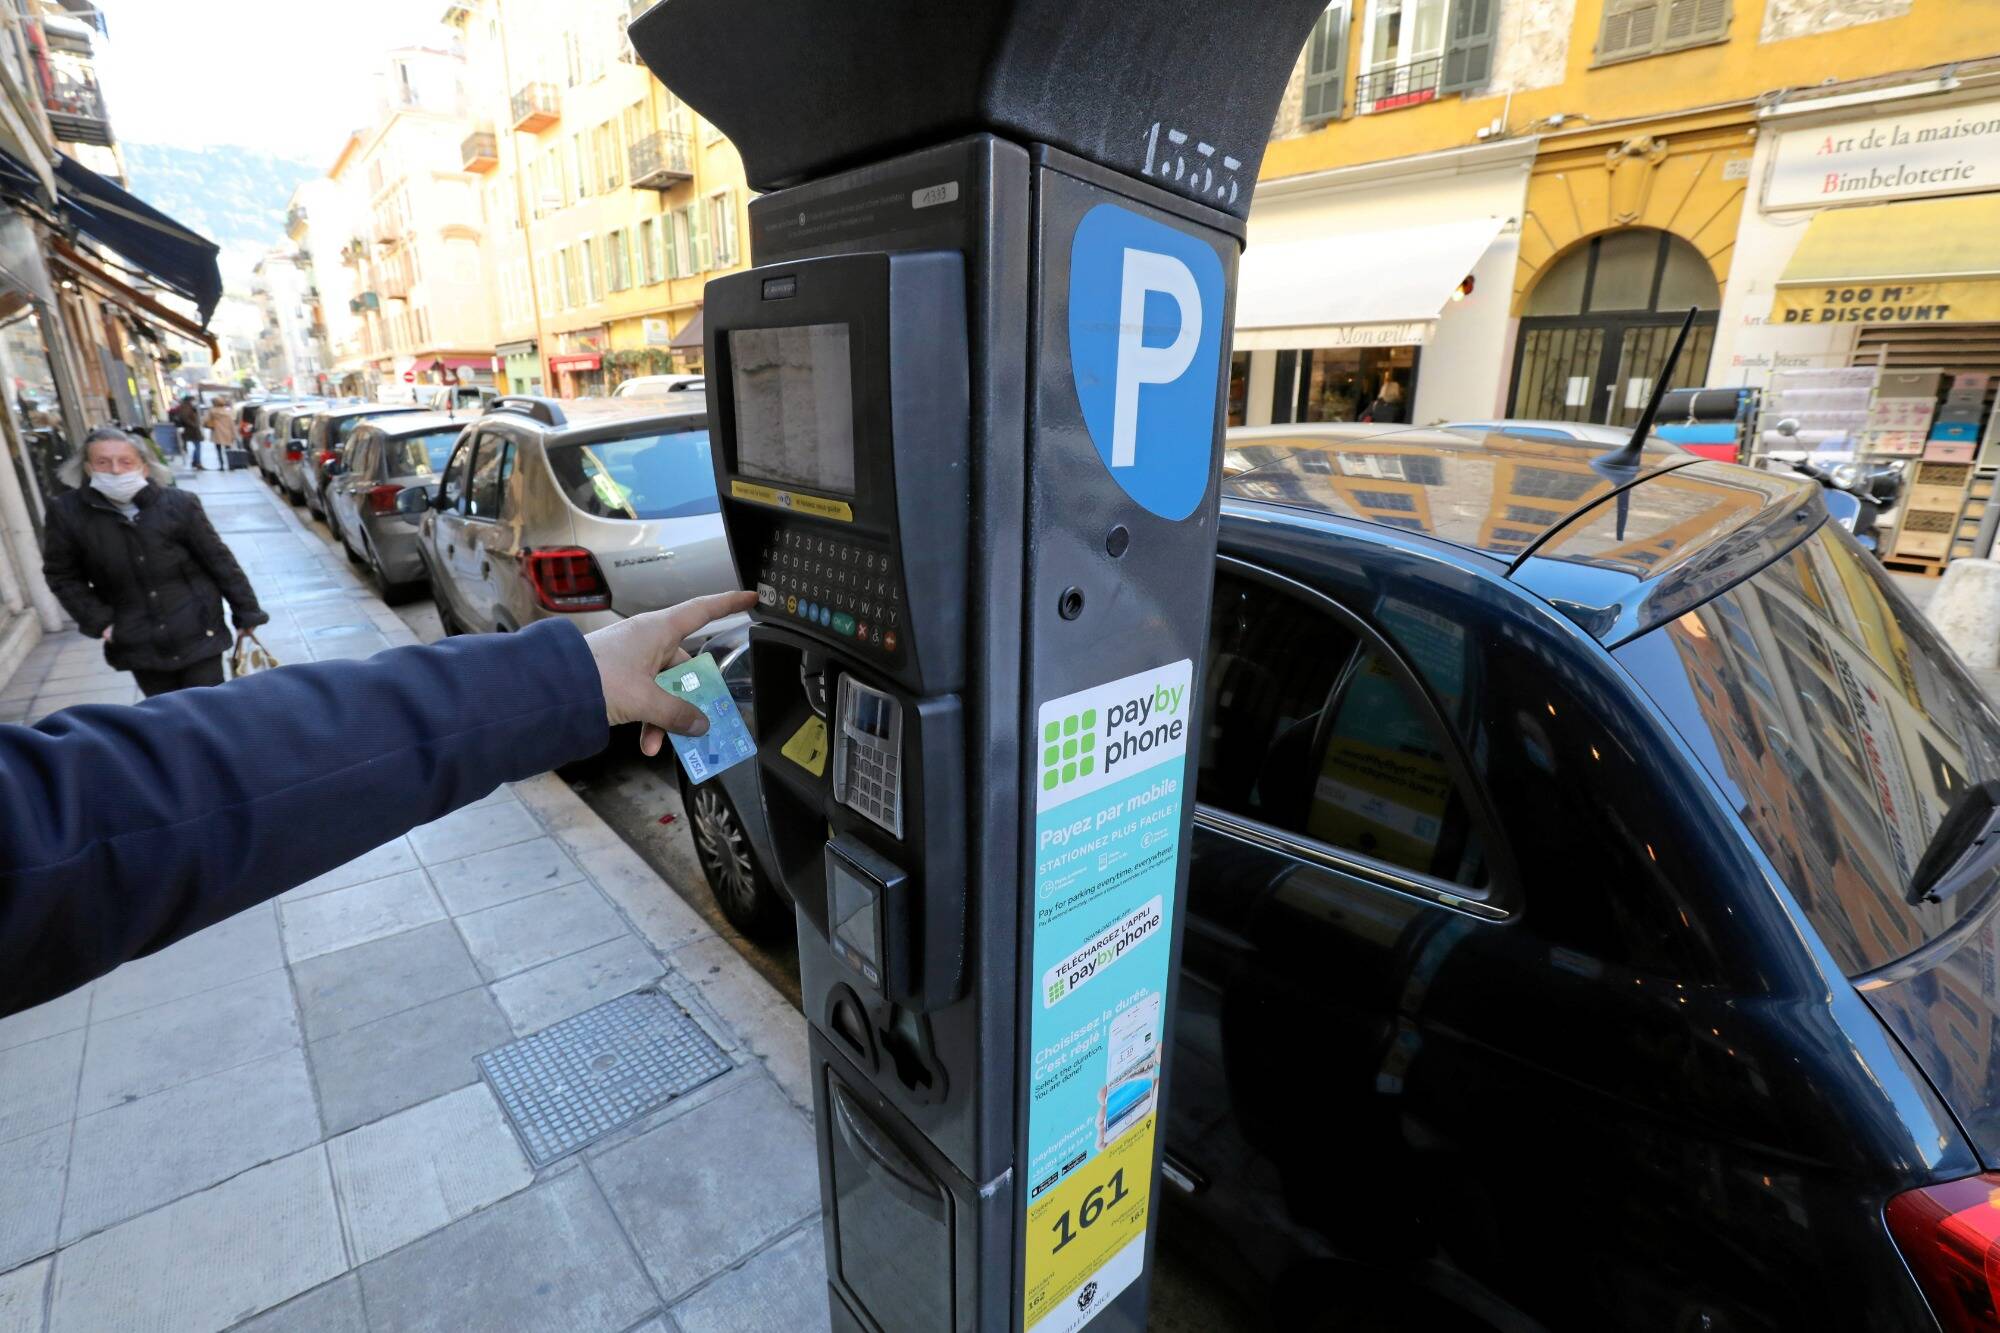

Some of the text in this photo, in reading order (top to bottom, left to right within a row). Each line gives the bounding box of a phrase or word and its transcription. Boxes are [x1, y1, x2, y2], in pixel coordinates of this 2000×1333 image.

[1816, 118, 2000, 155] Art de la maison
[1822, 160, 1975, 194] Bimbeloterie
[1783, 308, 1814, 322] DE
[1820, 304, 1951, 322] DISCOUNT
[1825, 287, 1873, 304] 200
[1335, 326, 1373, 345] Mon
[1111, 247, 1202, 467] P
[688, 752, 704, 775] VISA
[1104, 719, 1183, 774] phone
[1040, 778, 1177, 850] Payez par mobile
[1039, 836, 1109, 875] STATIONNEZ
[1111, 821, 1137, 842] PLUS
[1038, 904, 1052, 920] Pay
[1055, 898, 1066, 910] for
[1068, 884, 1094, 905] parking
[1055, 908, 1150, 977] TÉLÉCHARGEZ L'APPLI
[1069, 914, 1159, 989] paybyphone
[1035, 1017, 1100, 1064] Choisissez
[1102, 1011, 1112, 1022] la
[1035, 1055, 1067, 1080] C'est
[1035, 1074, 1059, 1093] Select
[1059, 1067, 1072, 1077] the
[1035, 1088, 1049, 1101] You
[1049, 1082, 1061, 1092] are
[1052, 1167, 1129, 1254] 161
